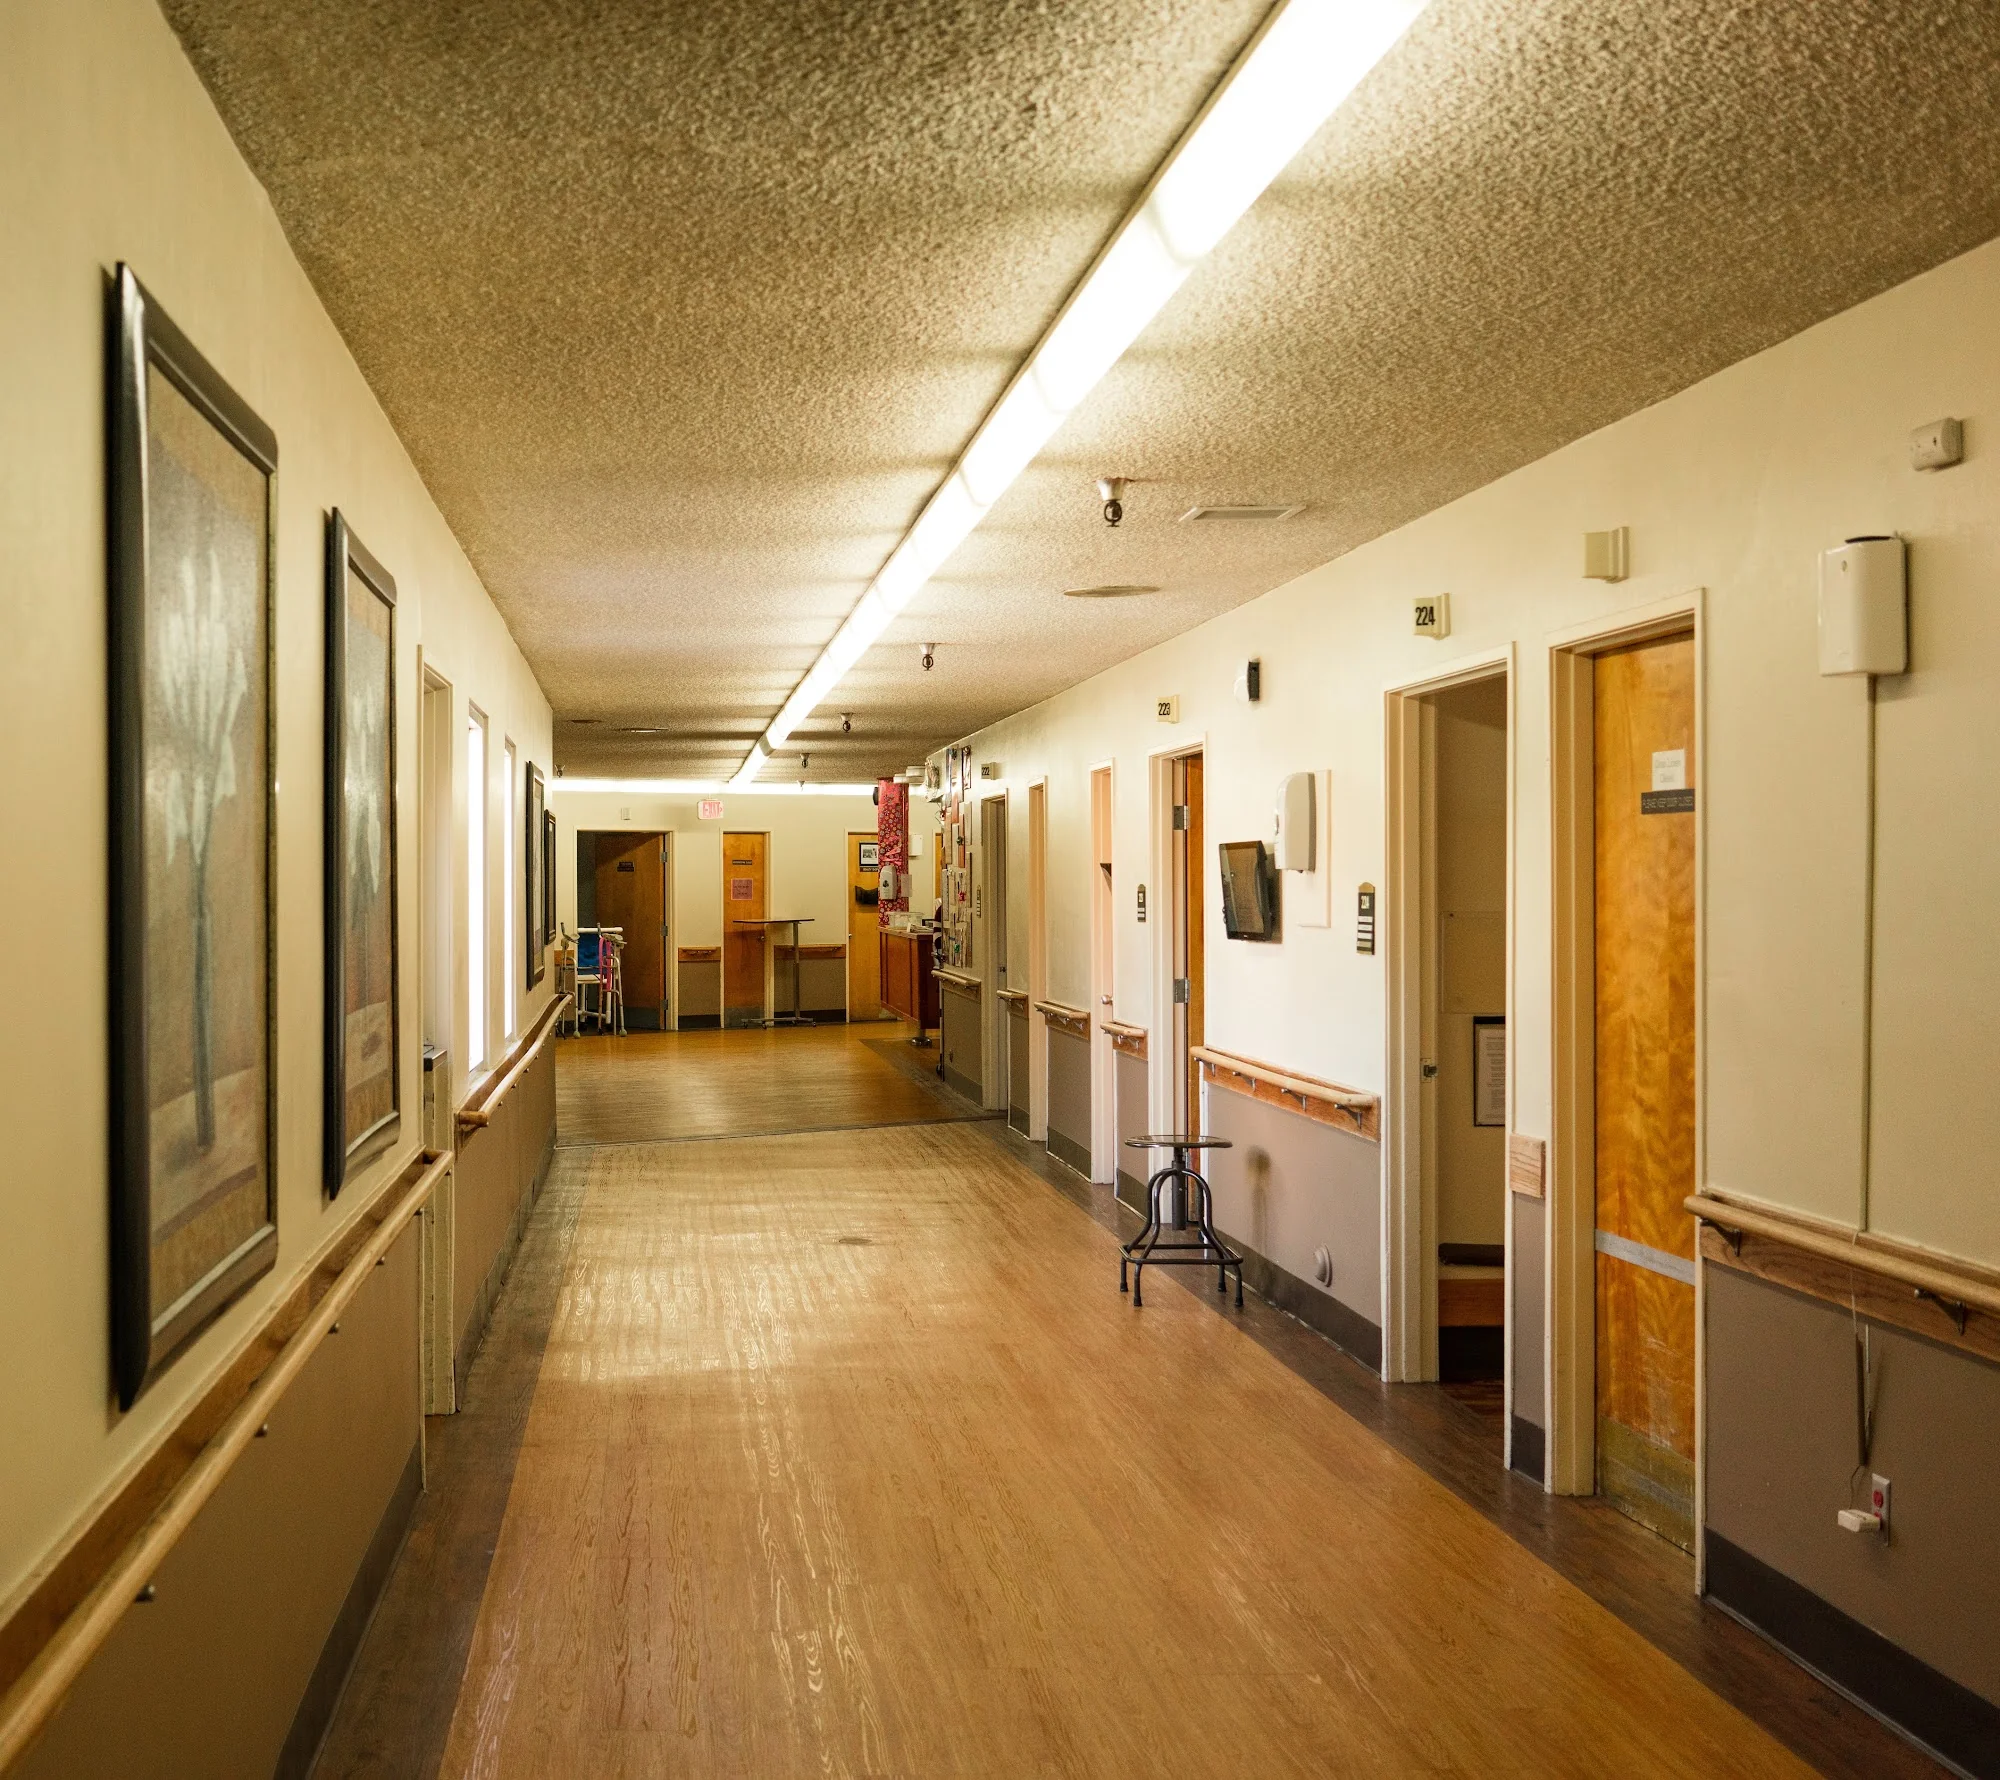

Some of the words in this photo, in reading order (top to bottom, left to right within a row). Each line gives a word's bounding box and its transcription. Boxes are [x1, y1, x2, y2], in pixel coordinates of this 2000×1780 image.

[1415, 606, 1436, 626] 224
[1158, 702, 1170, 716] 223
[702, 801, 720, 818] EXIT
